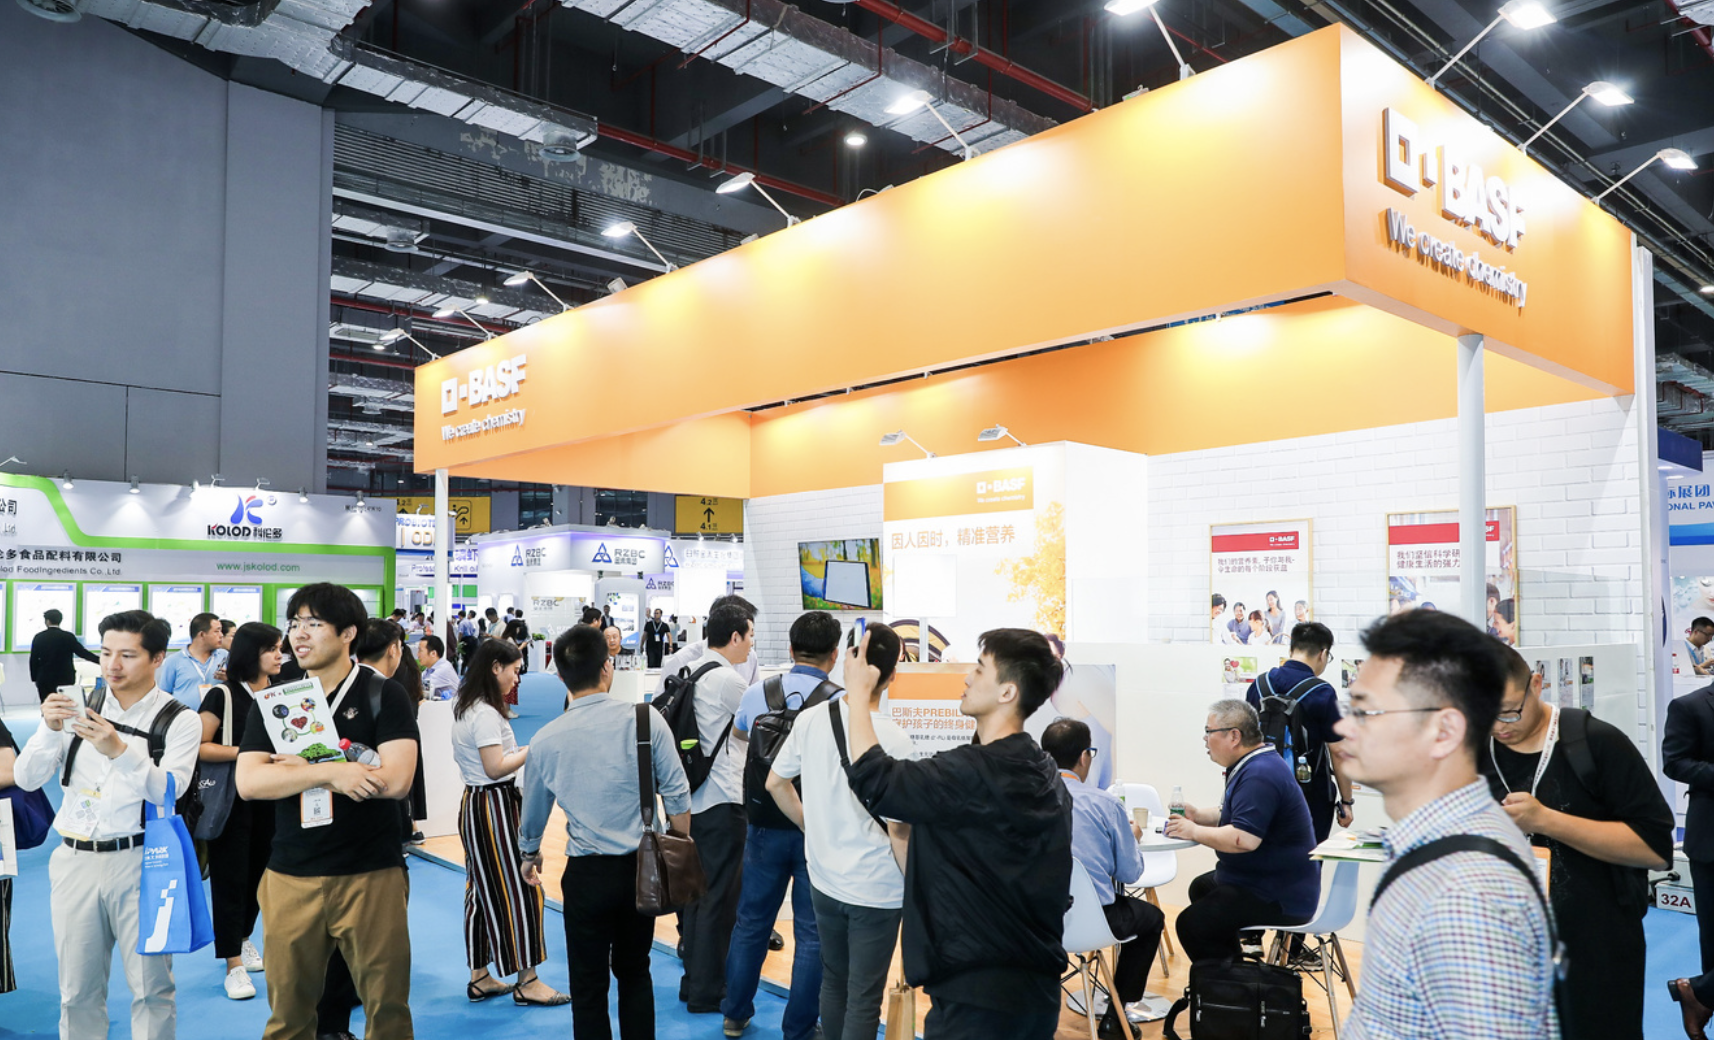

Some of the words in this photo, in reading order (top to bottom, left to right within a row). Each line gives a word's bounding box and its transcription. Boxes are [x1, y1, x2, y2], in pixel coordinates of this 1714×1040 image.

[1442, 145, 1525, 249] BASF
[1387, 207, 1416, 249] We
[1418, 232, 1464, 272] create
[1466, 252, 1527, 307] chemistry
[469, 354, 526, 406] BASF
[456, 419, 480, 437] create
[482, 408, 526, 431] chemistry
[993, 477, 1026, 493] BASF
[700, 497, 712, 506] 4.2
[207, 524, 251, 537] KOLOD
[253, 527, 282, 539] 科伦多
[700, 522, 711, 530] 4.1
[892, 525, 1015, 550] 因人因时，精准营养
[526, 548, 546, 558] RZBC
[614, 549, 645, 558] RZBC
[216, 562, 300, 573] www.jskolod.com
[533, 599, 559, 607] RZBC
[1661, 893, 1692, 908] 32A
